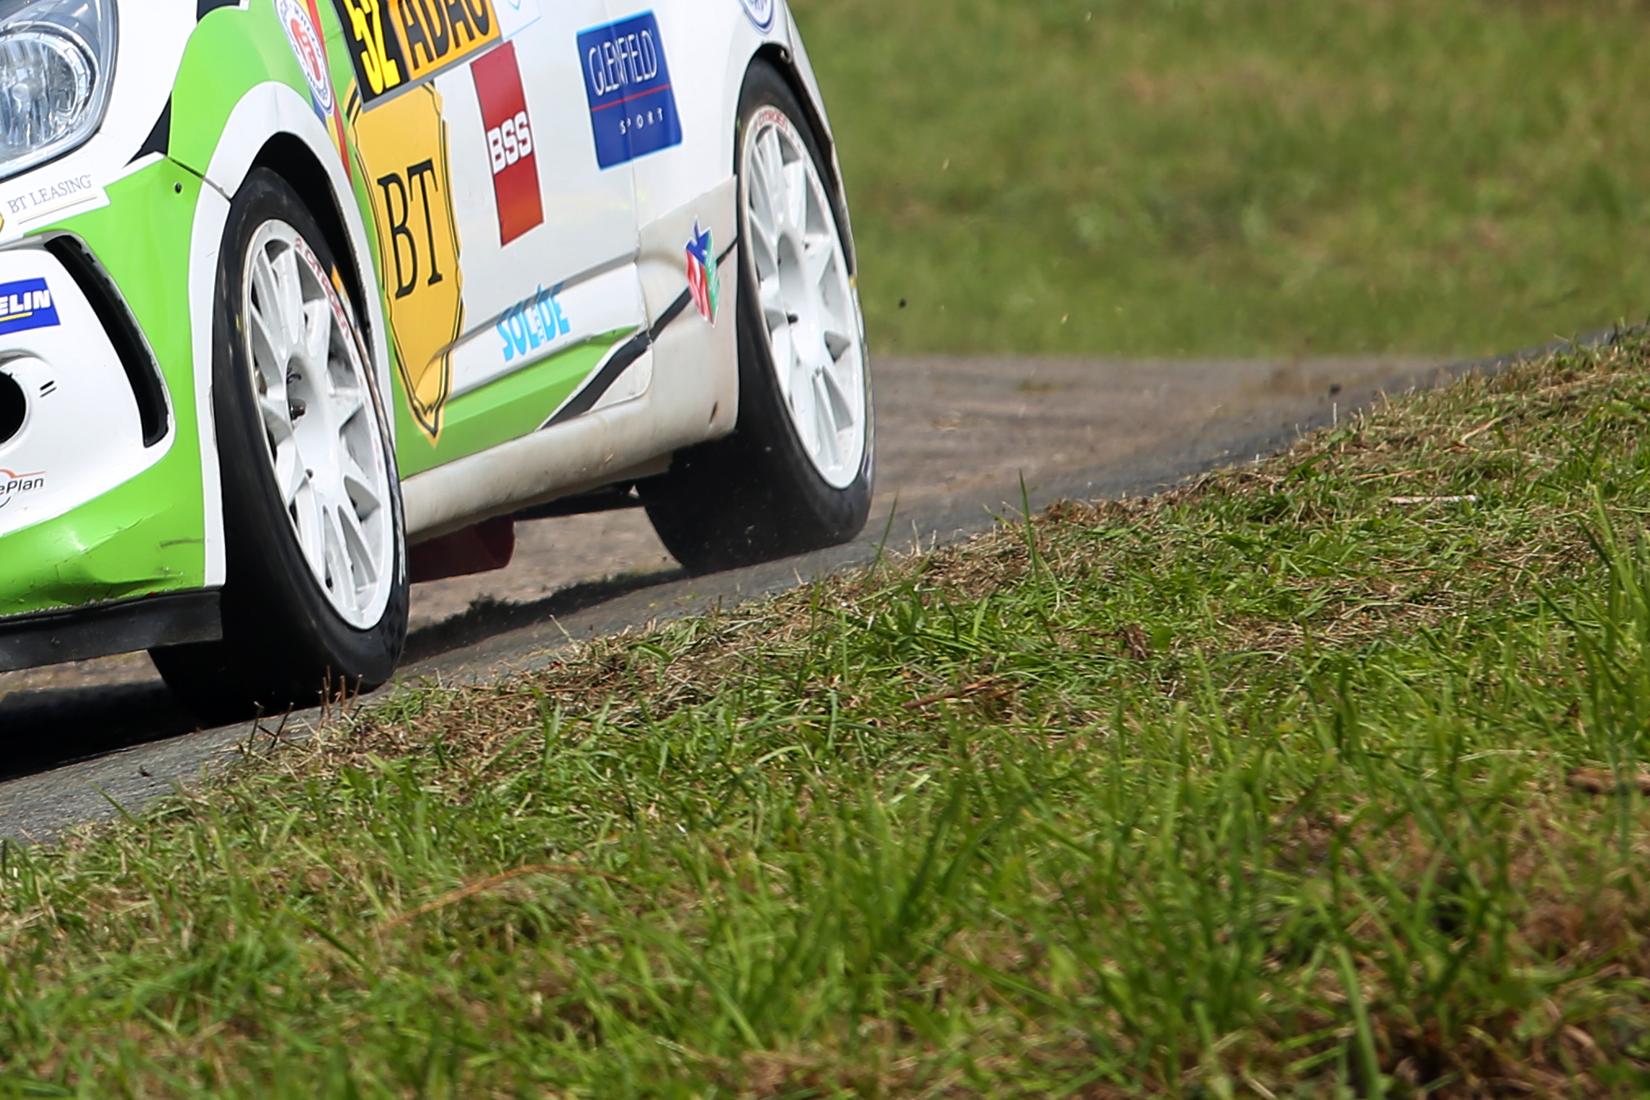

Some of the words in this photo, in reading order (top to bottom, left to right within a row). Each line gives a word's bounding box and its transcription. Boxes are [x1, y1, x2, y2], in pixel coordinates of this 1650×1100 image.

[486, 110, 533, 176] BSS
[619, 107, 665, 135] SPORT
[7, 196, 28, 214] BT
[29, 173, 92, 207] LEASING
[377, 157, 443, 300] BT
